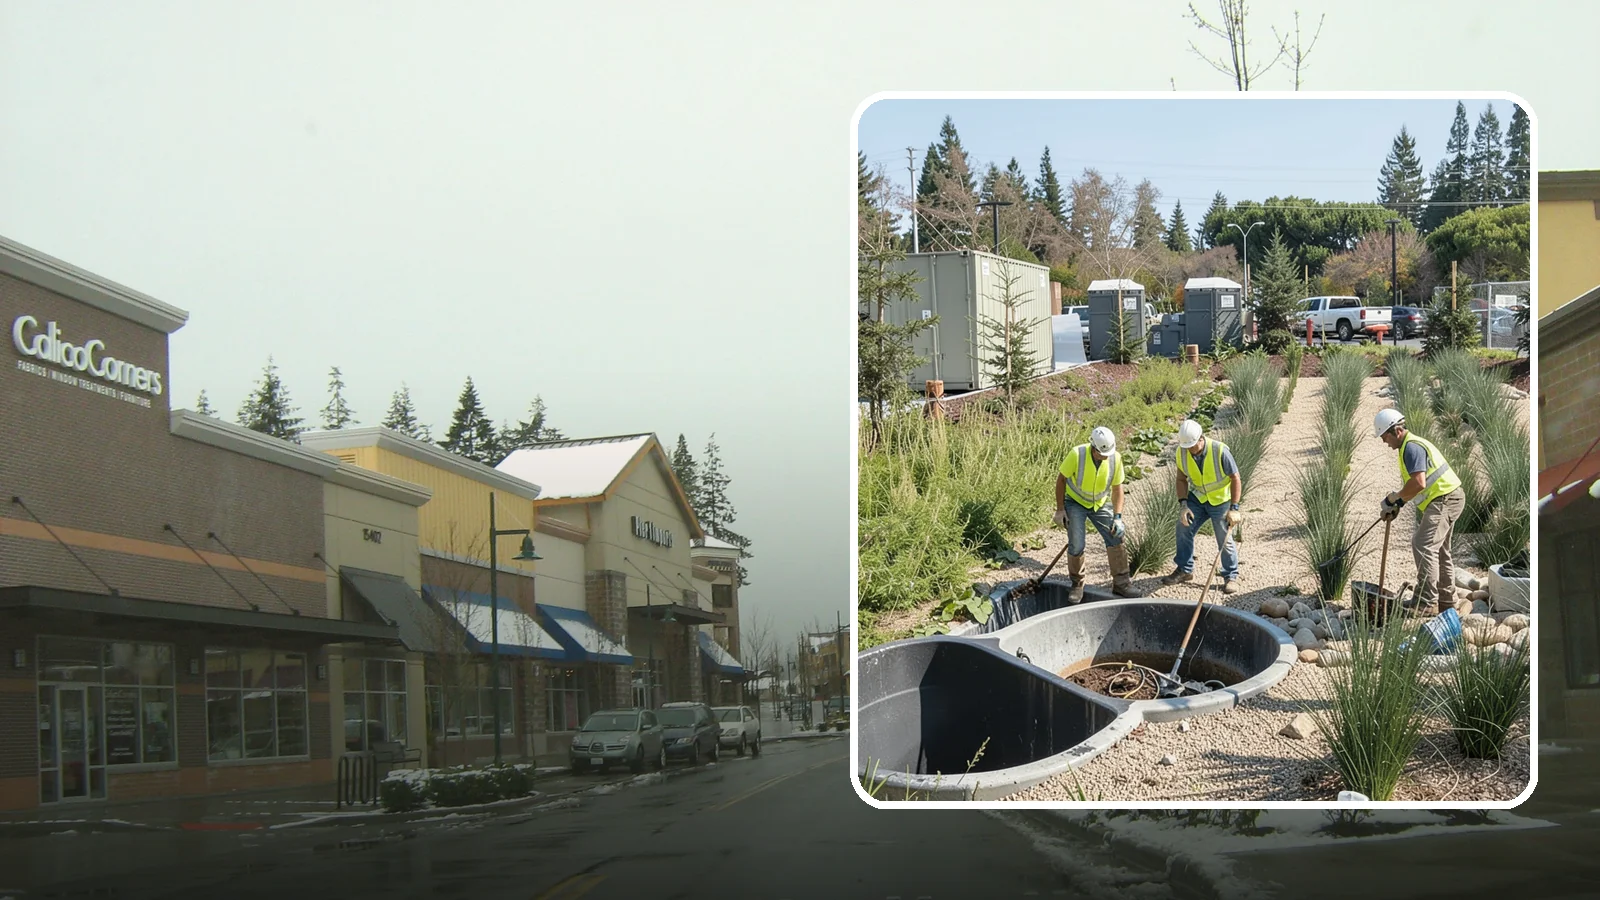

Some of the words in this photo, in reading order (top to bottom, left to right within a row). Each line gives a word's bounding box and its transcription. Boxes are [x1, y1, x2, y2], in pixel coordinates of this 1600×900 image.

[17, 360, 46, 377] FABRICS
[51, 371, 78, 386] WINDOW
[79, 379, 116, 398] TREATMENTS
[120, 393, 151, 408] FURNITURE
